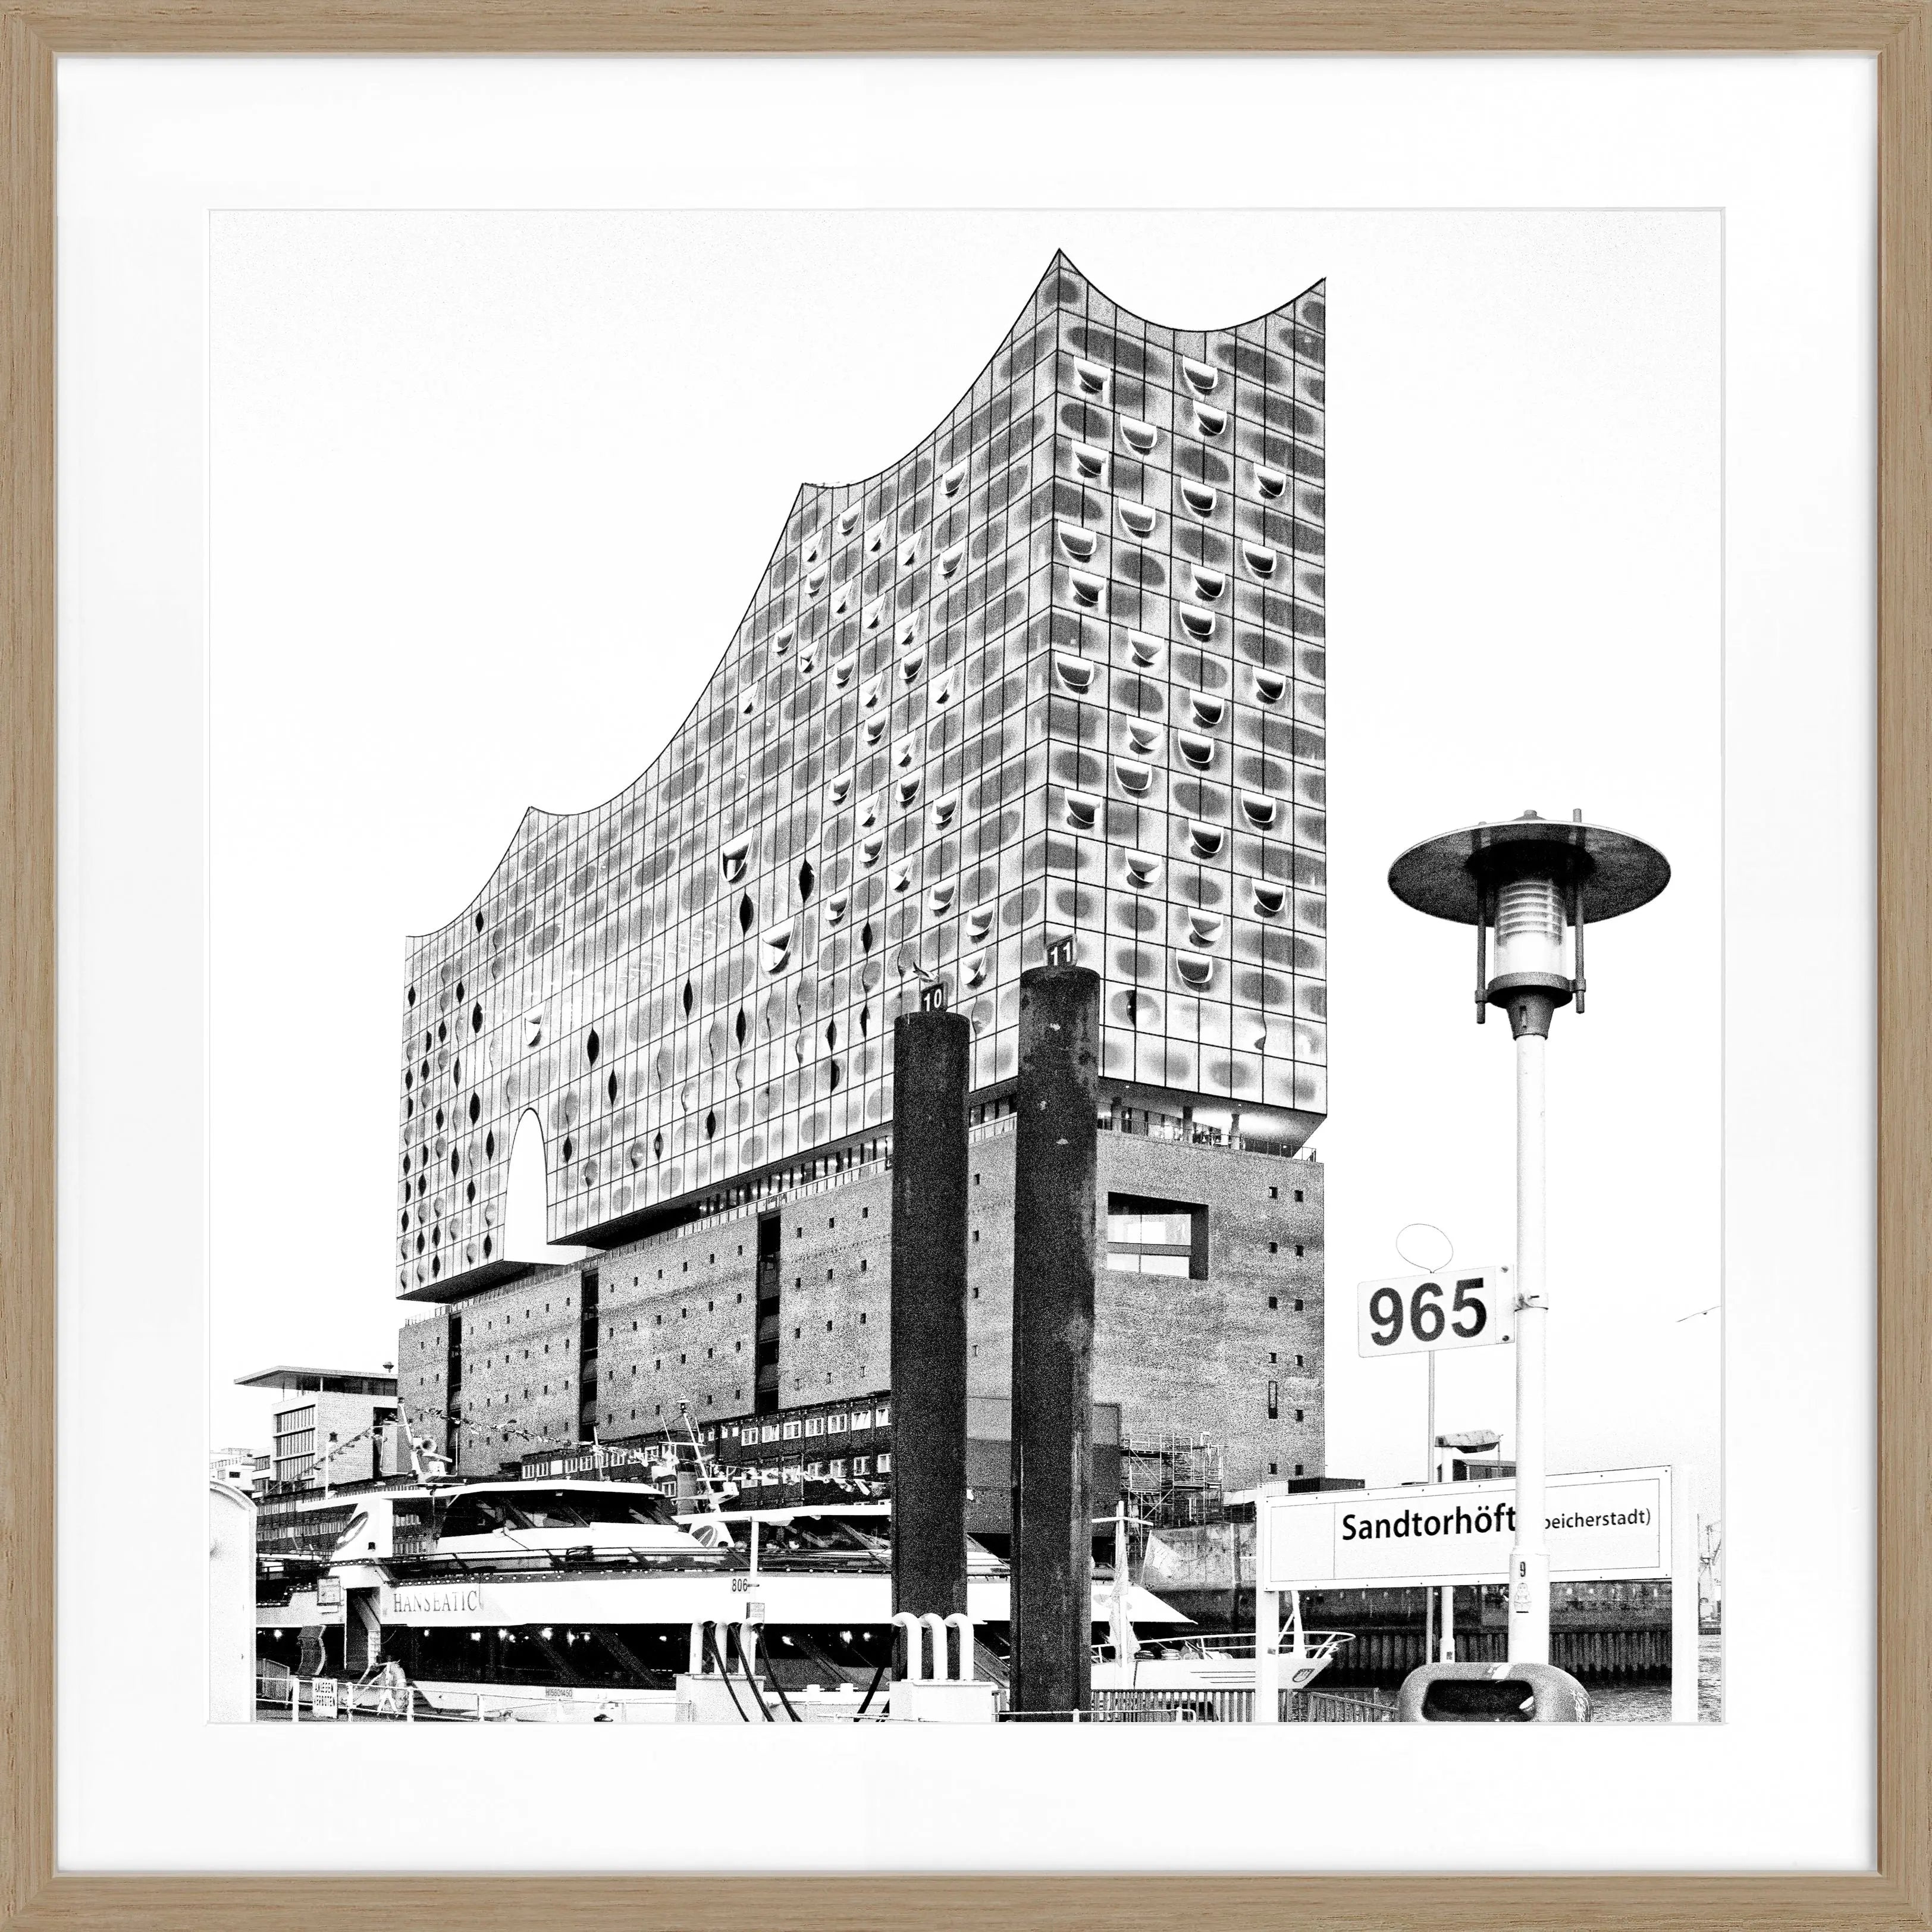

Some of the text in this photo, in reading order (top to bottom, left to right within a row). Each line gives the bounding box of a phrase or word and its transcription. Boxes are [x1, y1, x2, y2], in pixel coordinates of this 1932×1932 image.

[1050, 942, 1070, 965] 11
[924, 989, 942, 1011] 10
[1369, 1277, 1487, 1347] 965
[1343, 1503, 1516, 1541] Sandtorhöft
[1520, 1561, 1526, 1577] 9
[732, 1578, 748, 1592] 806
[393, 1590, 477, 1612] HANSEATIC
